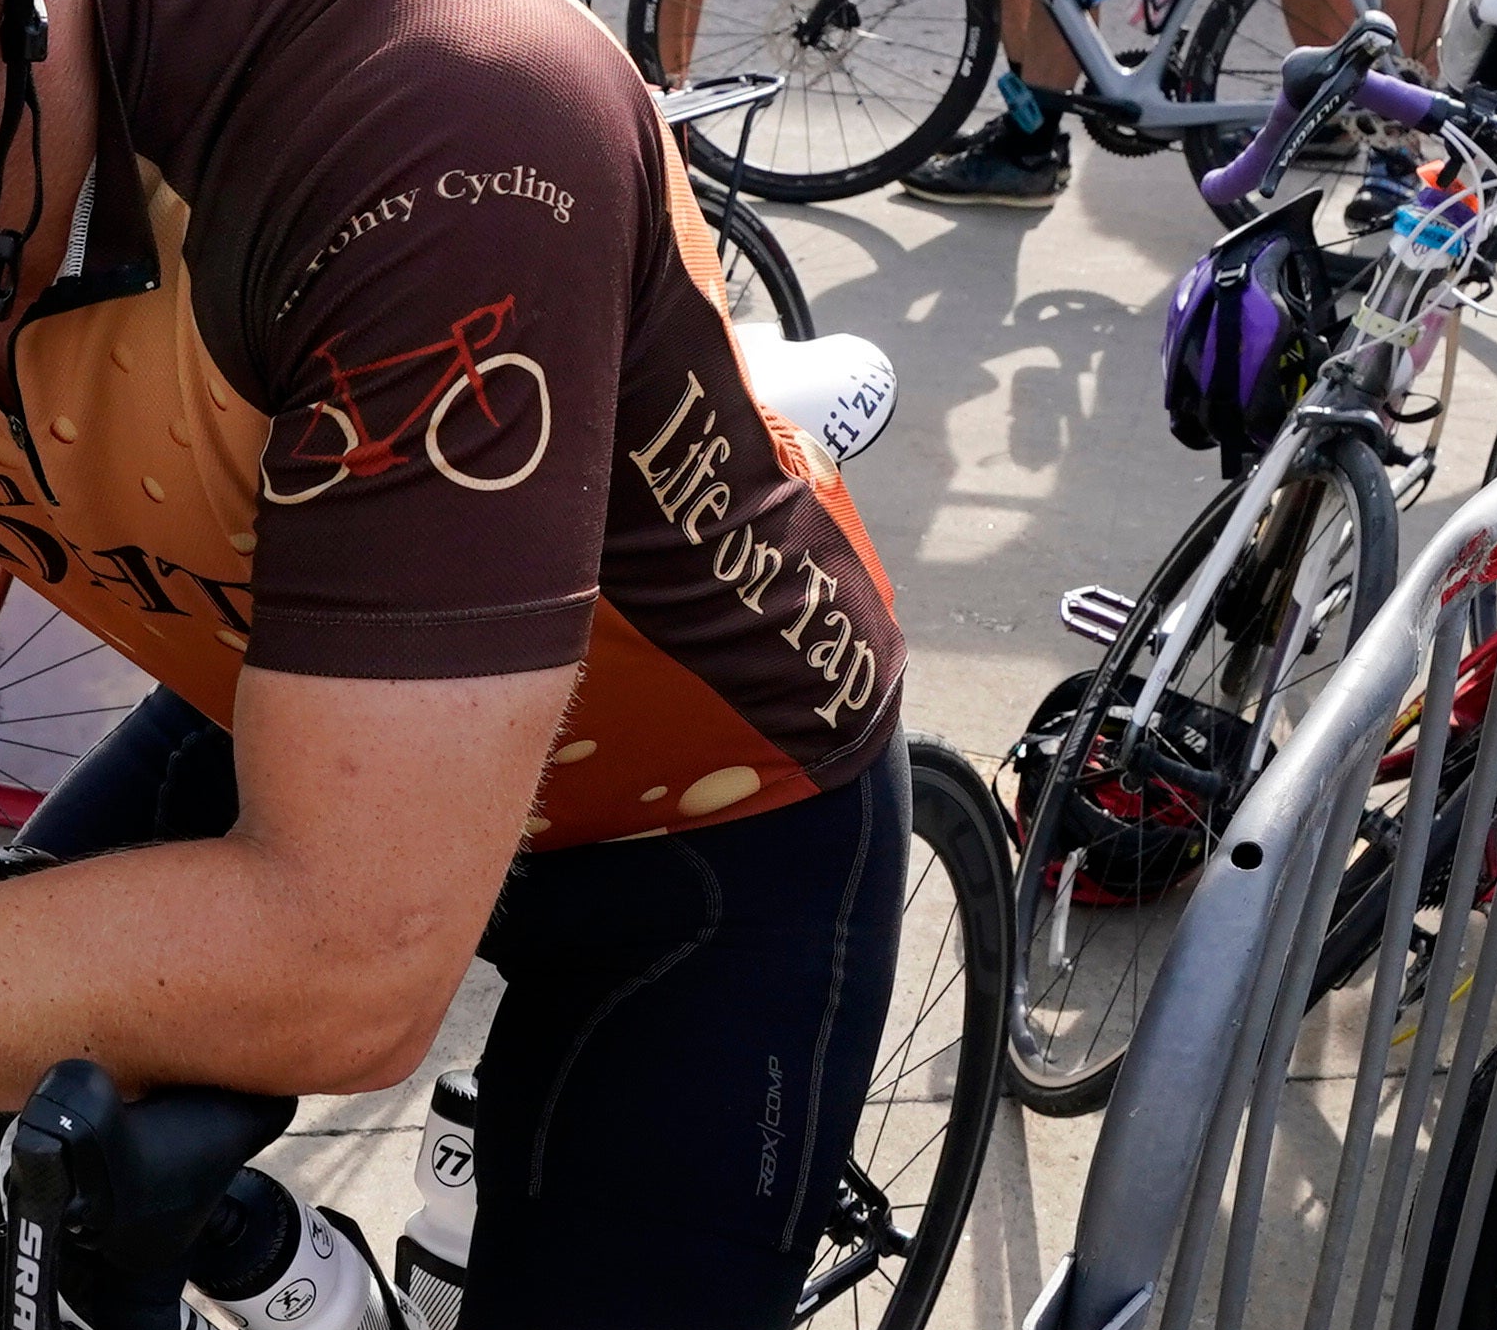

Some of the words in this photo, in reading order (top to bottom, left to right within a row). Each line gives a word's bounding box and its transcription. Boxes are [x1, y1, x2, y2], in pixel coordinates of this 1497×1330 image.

[1278, 94, 1342, 168] ULTEGRA
[435, 165, 577, 223] Cycling
[628, 369, 733, 546] Life
[714, 523, 783, 616] on
[779, 549, 877, 729] Tap
[435, 1144, 472, 1177] 77
